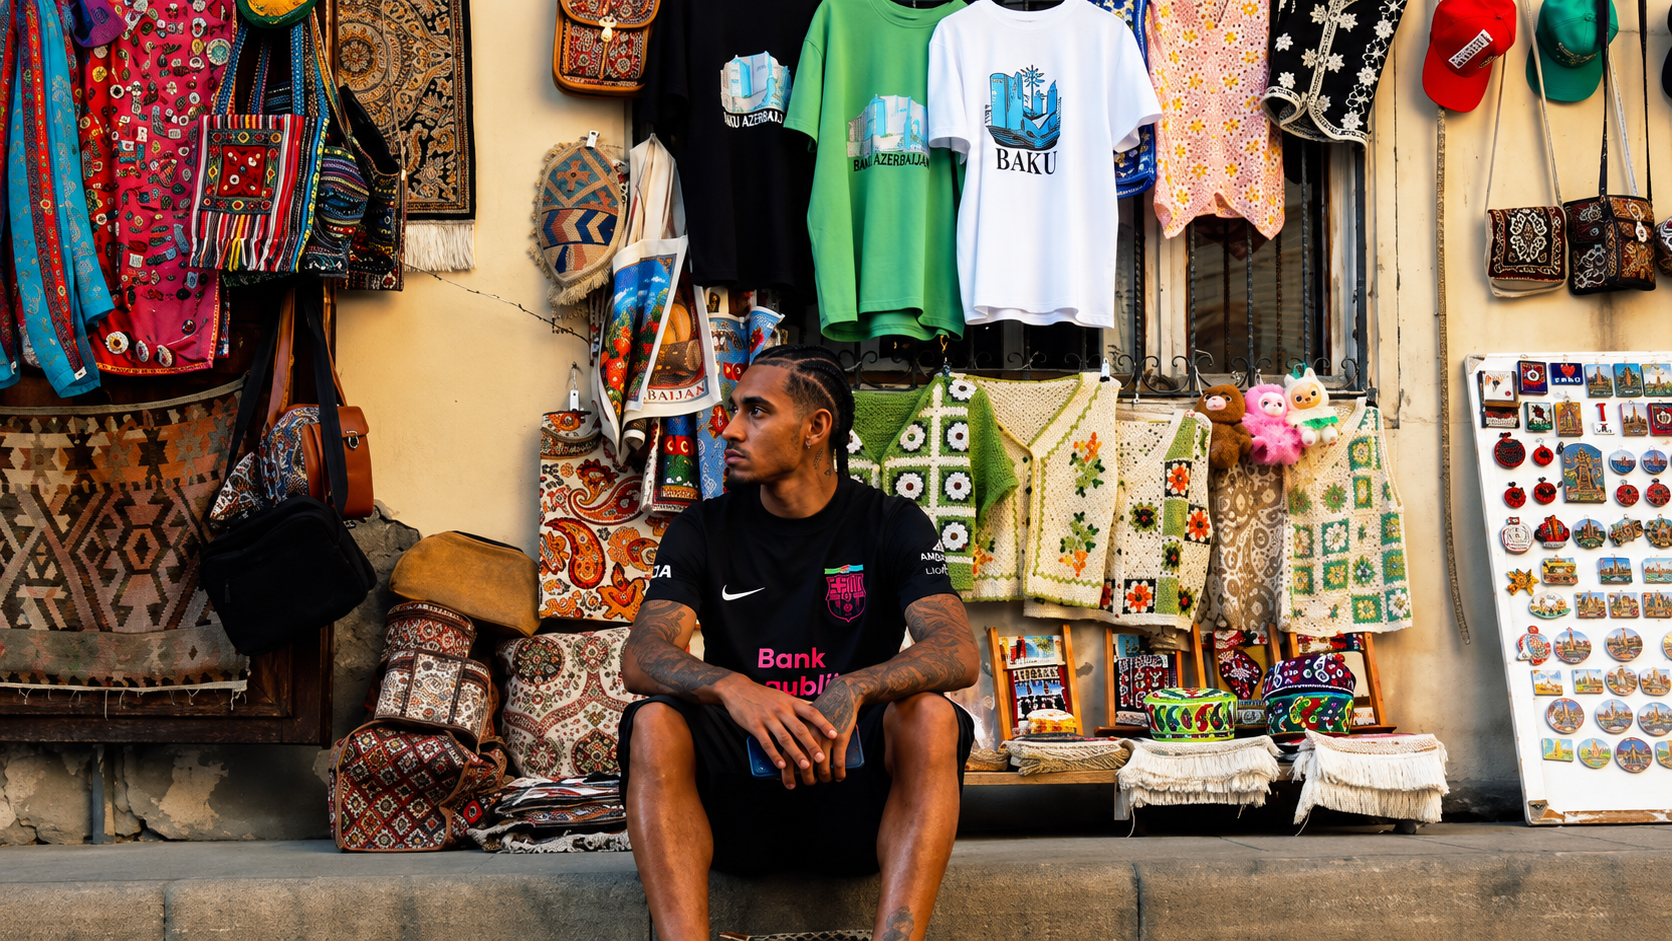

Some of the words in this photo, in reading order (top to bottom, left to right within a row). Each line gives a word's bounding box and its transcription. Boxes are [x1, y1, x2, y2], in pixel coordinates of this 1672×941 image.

[995, 147, 1058, 175] BAKU
[643, 382, 705, 401] BAIJAN
[757, 646, 827, 669] Bank
